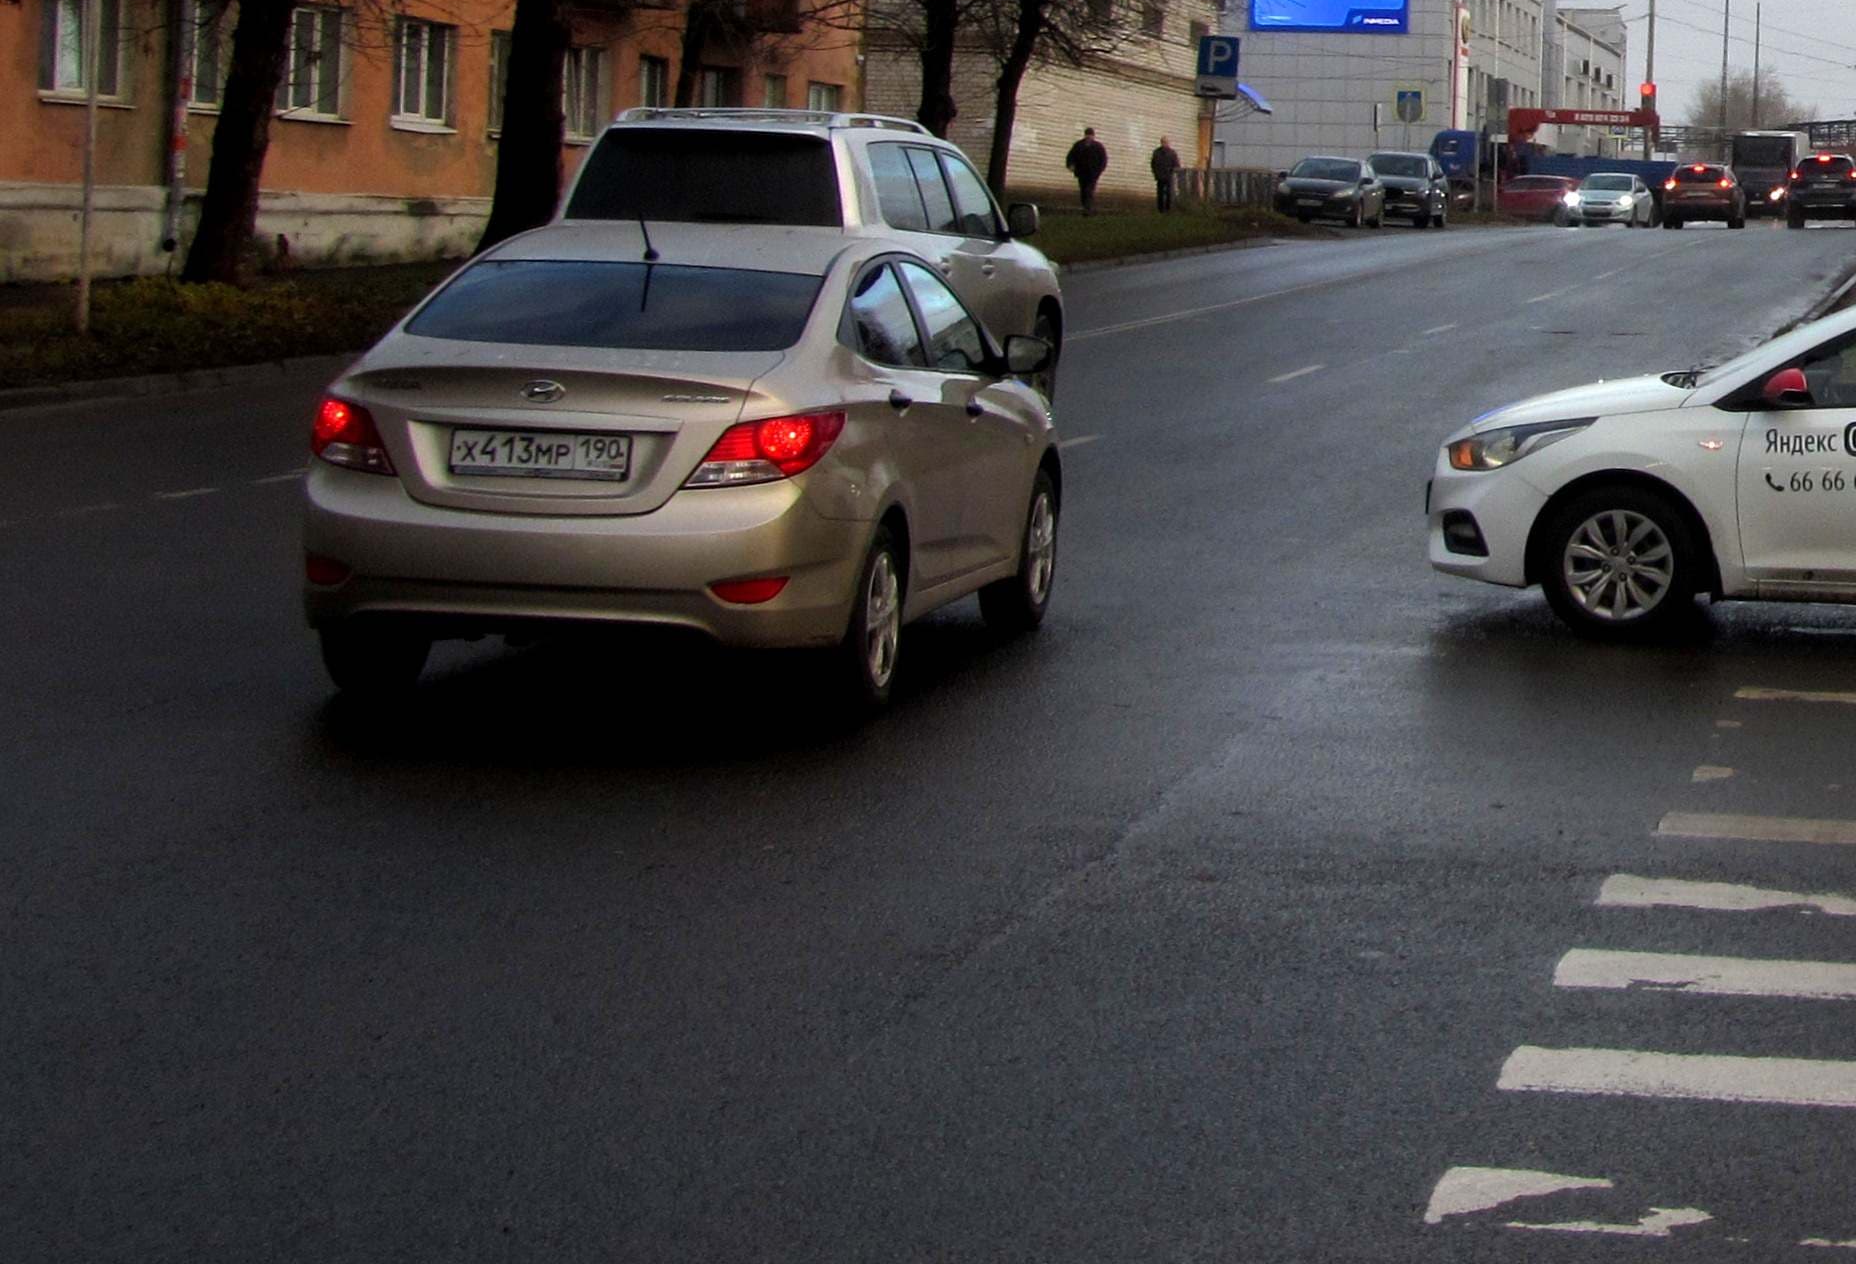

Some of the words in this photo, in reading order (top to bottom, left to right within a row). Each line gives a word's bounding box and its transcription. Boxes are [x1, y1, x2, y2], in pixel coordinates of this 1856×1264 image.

[460, 436, 571, 465] Х413МР
[579, 438, 622, 460] 190
[1765, 428, 1838, 456] Яндекс
[1790, 471, 1814, 492] 66
[1821, 470, 1846, 492] 66
